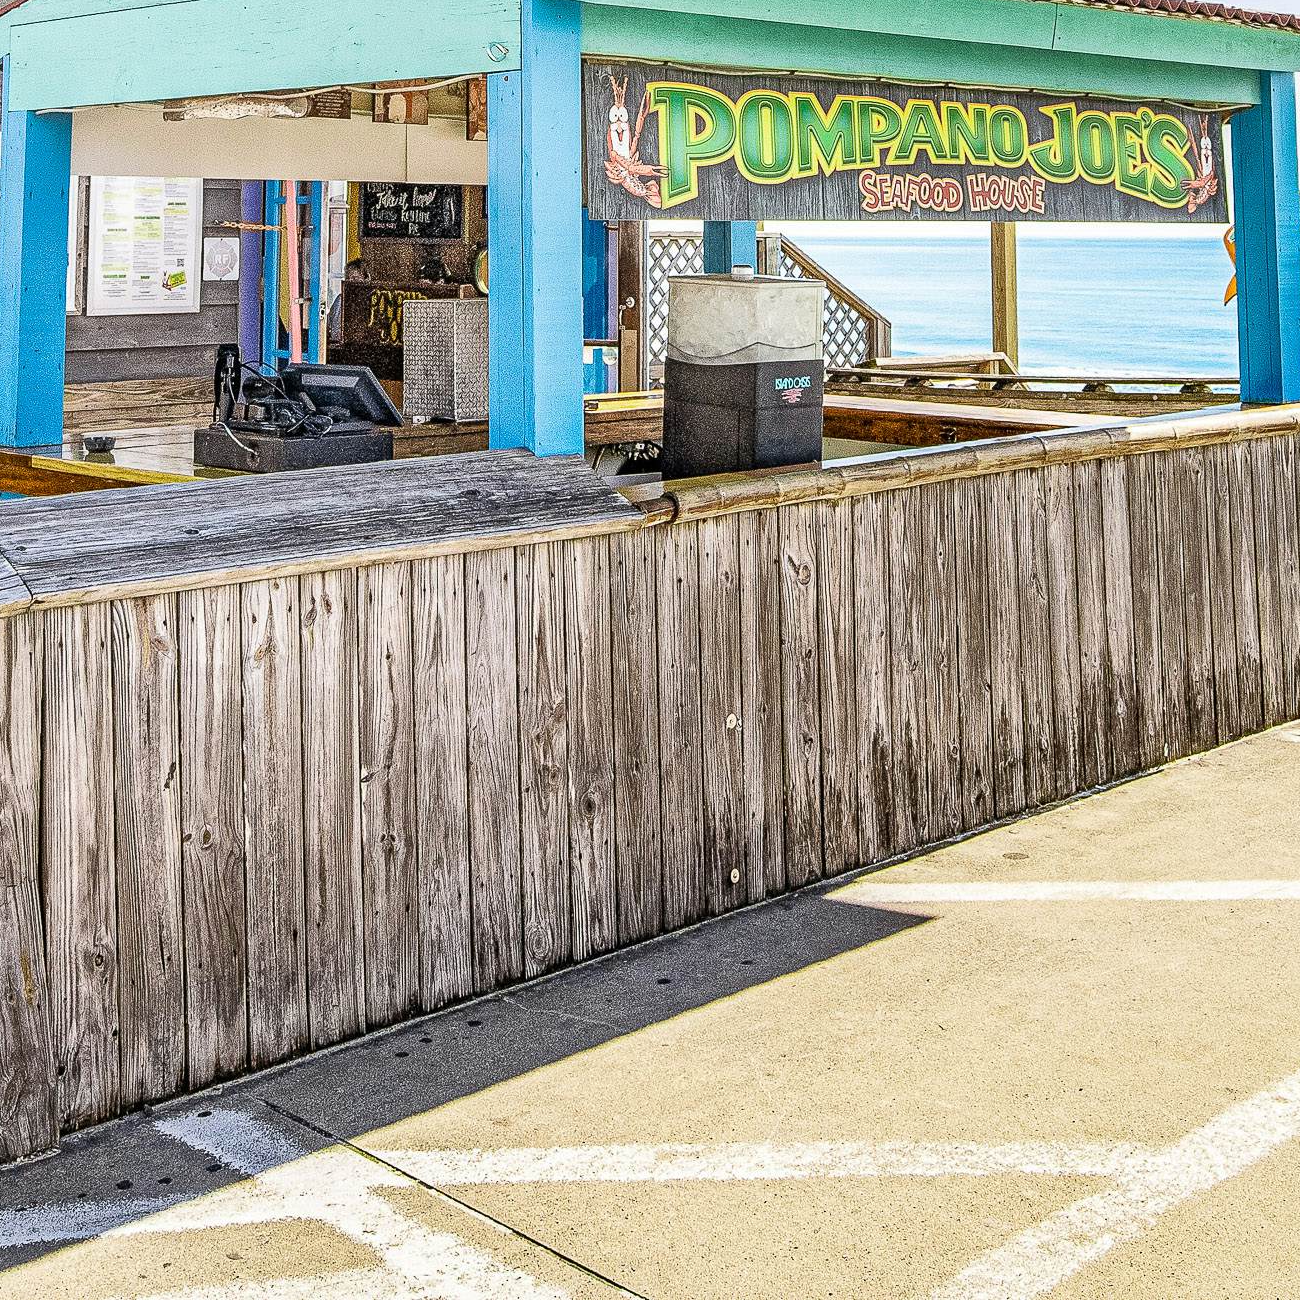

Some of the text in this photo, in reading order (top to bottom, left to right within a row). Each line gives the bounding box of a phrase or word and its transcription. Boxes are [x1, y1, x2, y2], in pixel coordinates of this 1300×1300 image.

[647, 82, 1196, 210] POMPANO JOE'S
[859, 170, 1046, 214] SEAFOOD HOUSE
